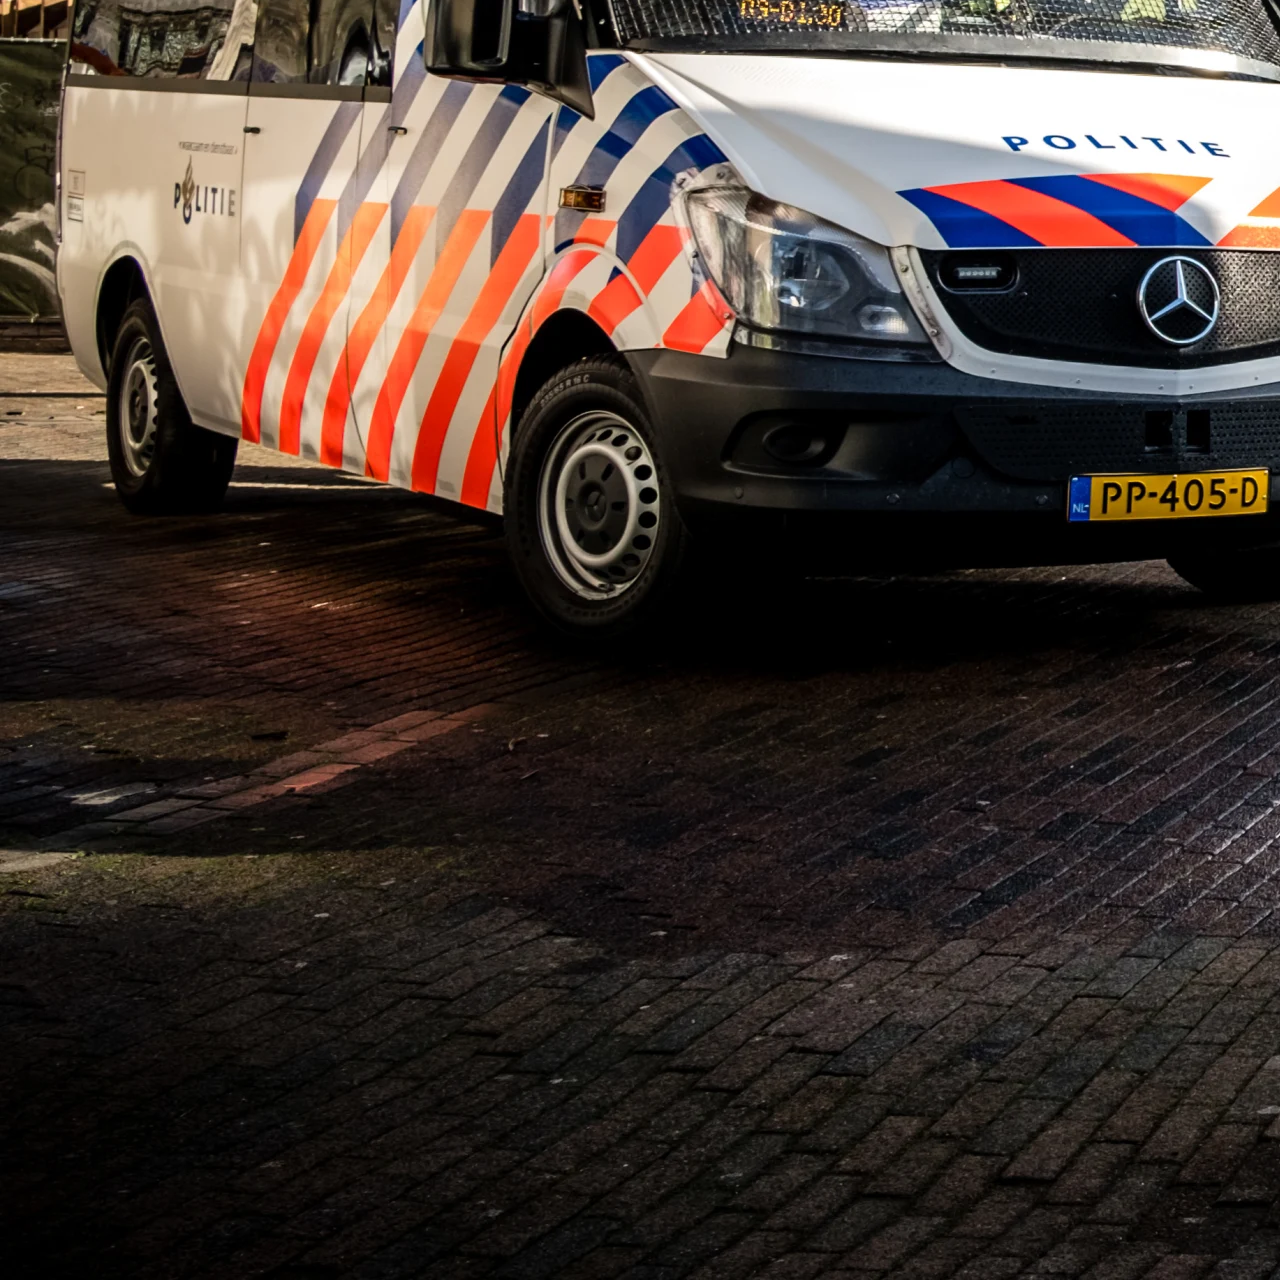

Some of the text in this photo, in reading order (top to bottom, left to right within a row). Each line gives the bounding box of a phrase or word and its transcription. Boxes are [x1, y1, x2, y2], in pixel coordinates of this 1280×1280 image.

[1001, 134, 1231, 158] POLITIE
[174, 182, 236, 225] POLITIE
[1073, 503, 1087, 513] NL
[1101, 476, 1259, 515] PP-405-D
